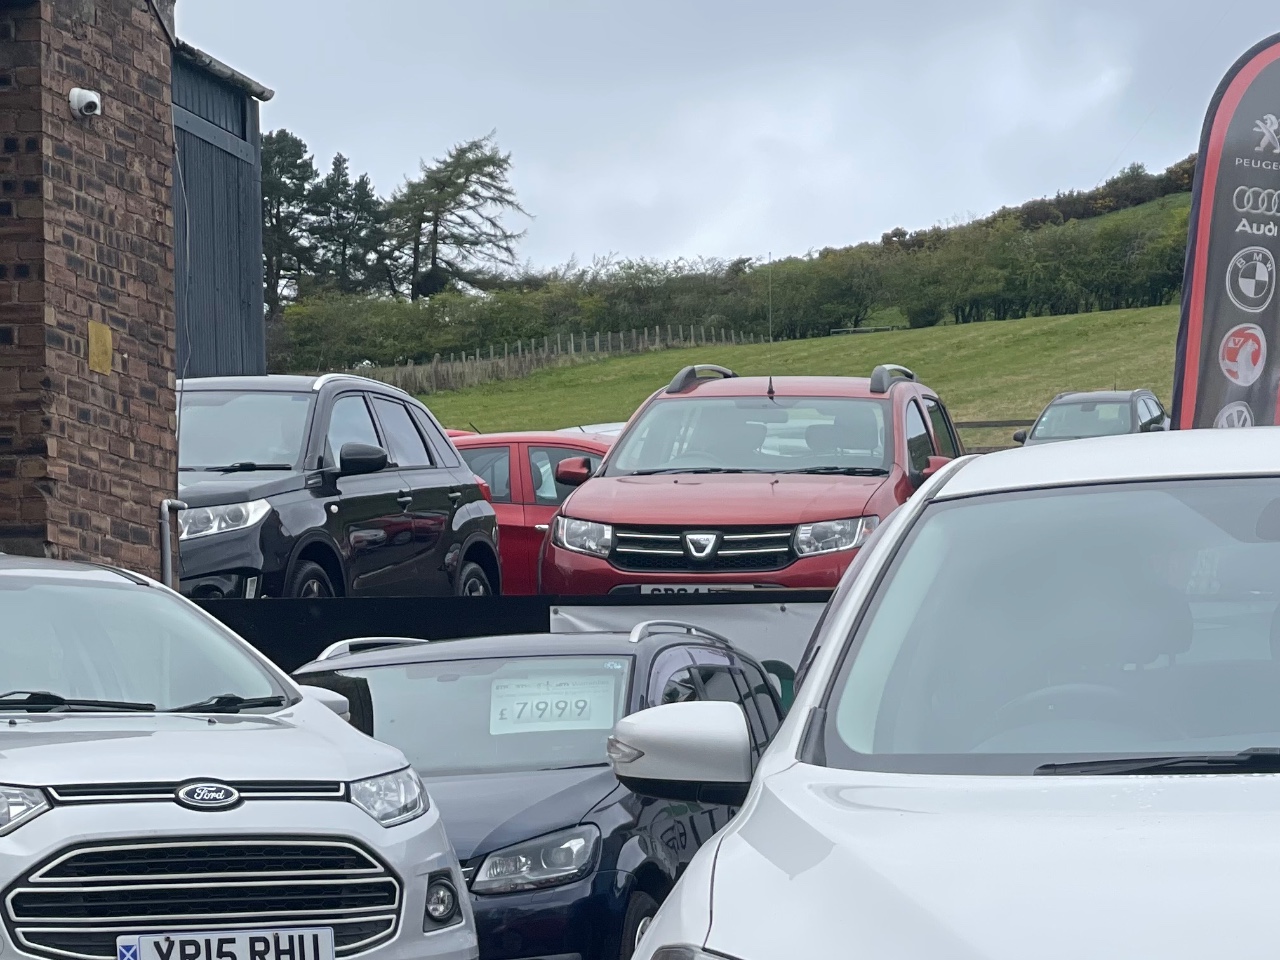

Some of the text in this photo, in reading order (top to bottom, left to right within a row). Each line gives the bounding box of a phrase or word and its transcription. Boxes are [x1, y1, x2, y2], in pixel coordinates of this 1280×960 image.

[1235, 217, 1278, 237] Audi
[1236, 252, 1273, 272] BMW
[193, 786, 226, 800] Ford
